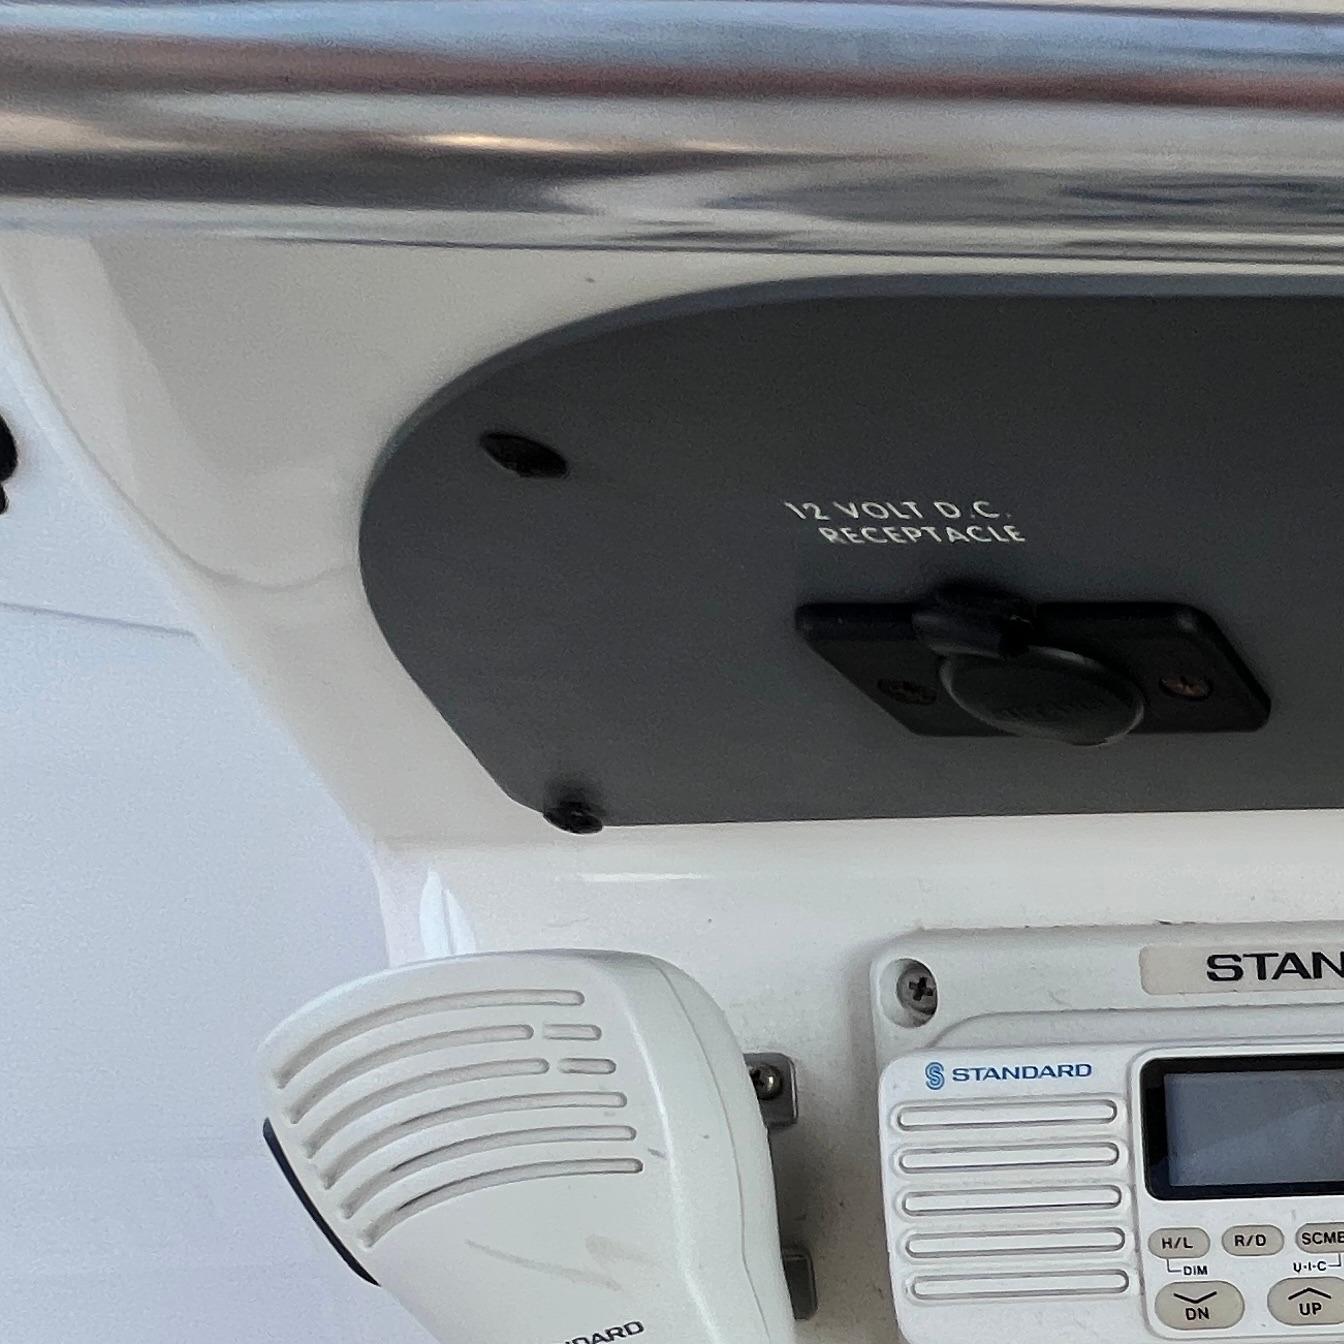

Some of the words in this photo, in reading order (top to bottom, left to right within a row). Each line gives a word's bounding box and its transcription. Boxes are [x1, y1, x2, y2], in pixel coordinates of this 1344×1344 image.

[784, 500, 832, 521] 12
[834, 500, 924, 520] VOLT
[817, 524, 1028, 545] RECEPTACLE
[951, 1062, 1093, 1083] STANDARD
[1161, 1237, 1194, 1250] H/L
[1234, 1233, 1267, 1248] R/D
[1183, 1265, 1208, 1276] DIM
[1185, 1307, 1211, 1321] DN
[1299, 1302, 1323, 1317] UP
